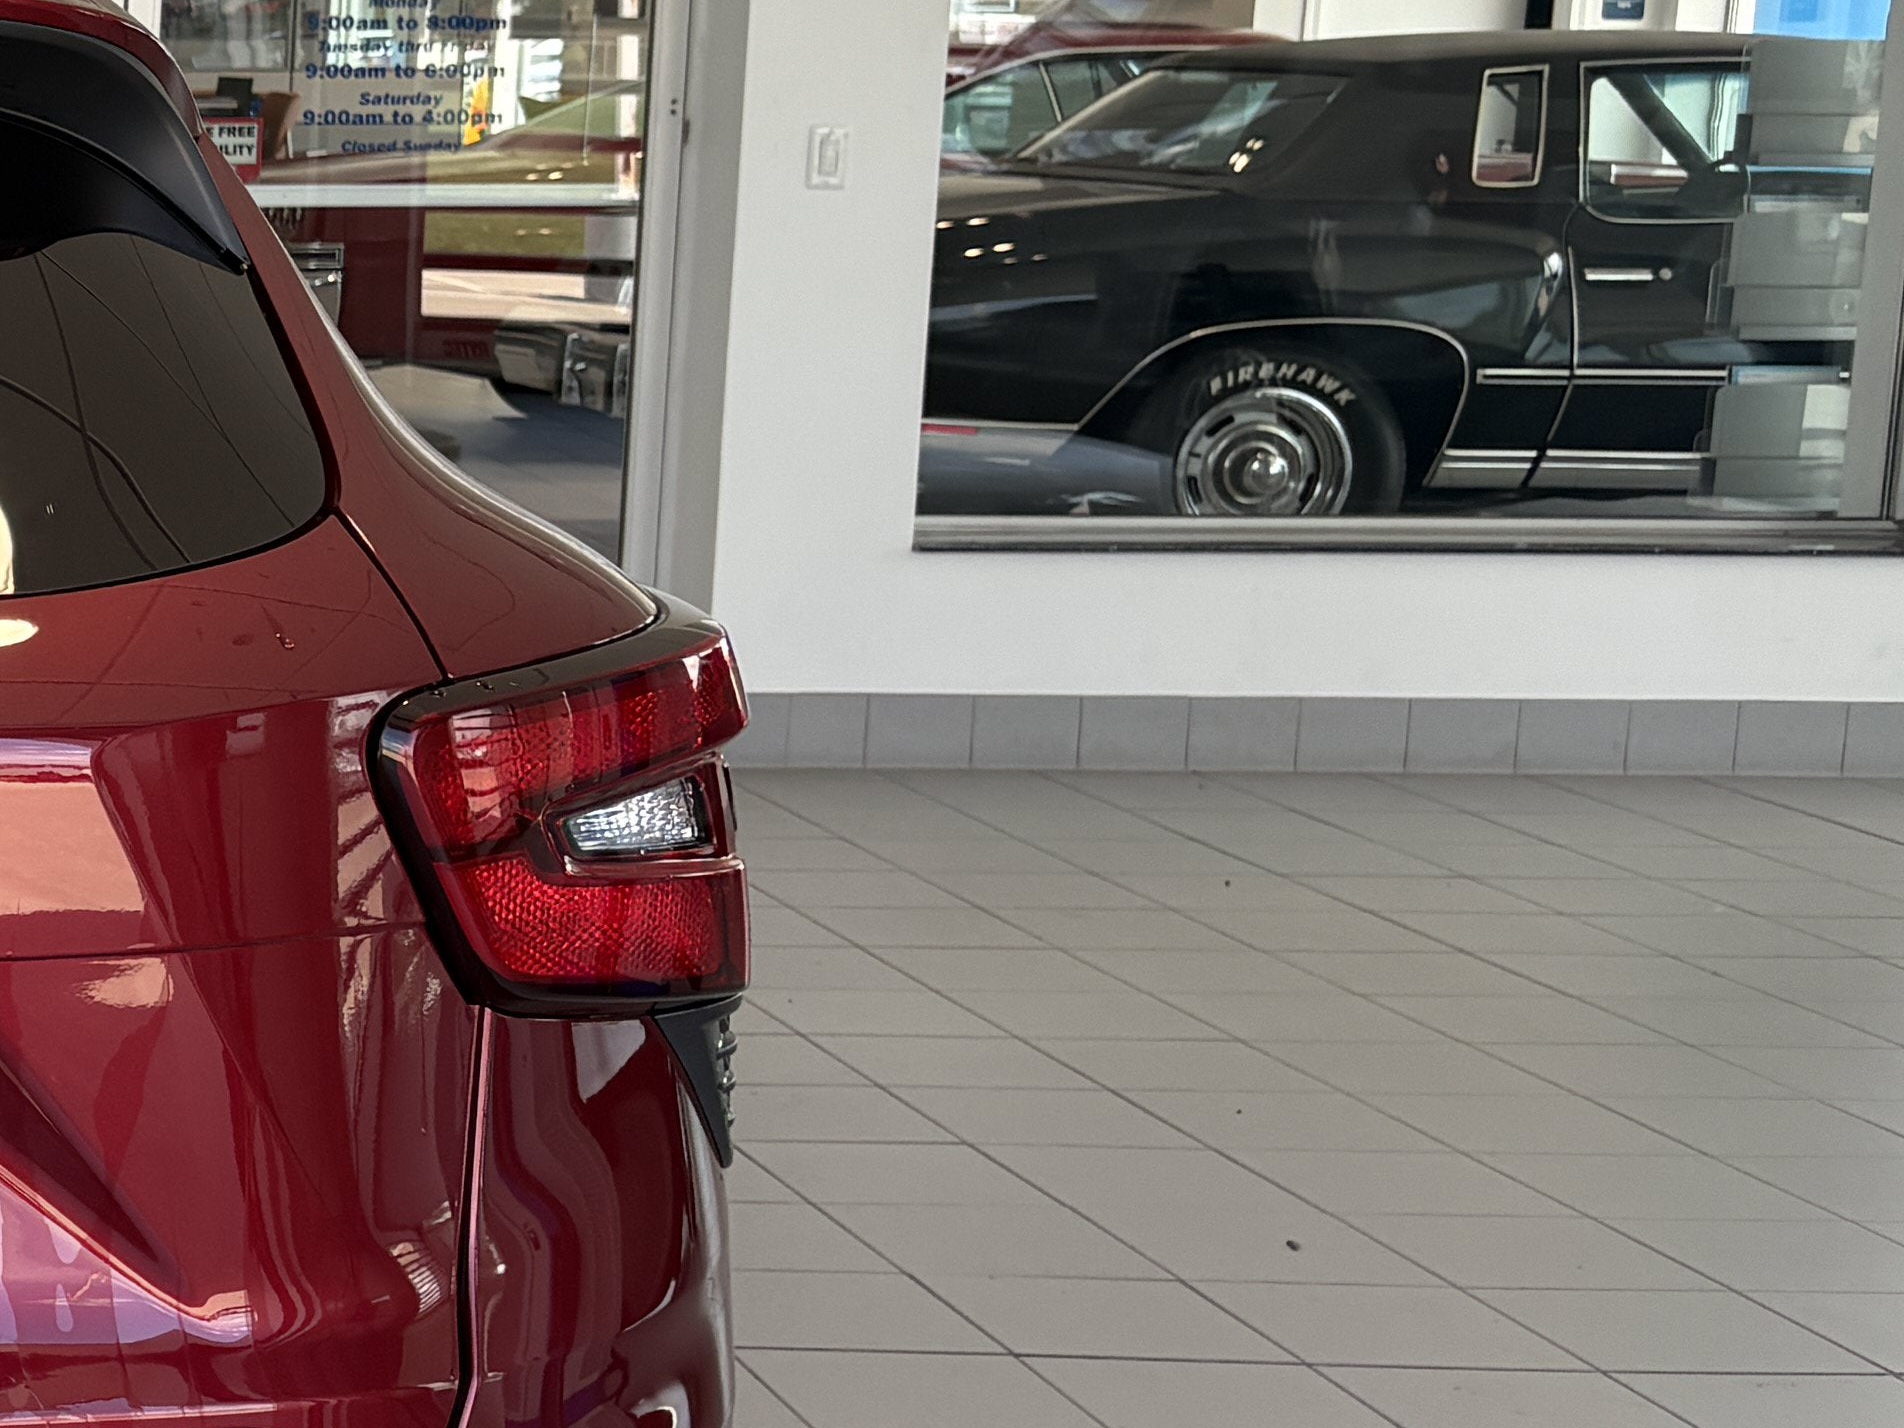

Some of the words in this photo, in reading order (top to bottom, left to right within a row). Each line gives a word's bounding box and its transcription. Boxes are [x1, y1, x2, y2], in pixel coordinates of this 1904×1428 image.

[396, 14, 418, 31] to
[305, 62, 387, 80] 9:00am
[394, 62, 416, 80] to
[424, 62, 506, 82] 6:00pm
[358, 92, 444, 108] Saturday
[302, 109, 386, 126] 9:00am
[392, 109, 416, 126] to
[421, 109, 504, 128] 4:00pm
[218, 126, 256, 138] FREE
[219, 144, 254, 157] ILITY
[341, 139, 398, 154] Closed
